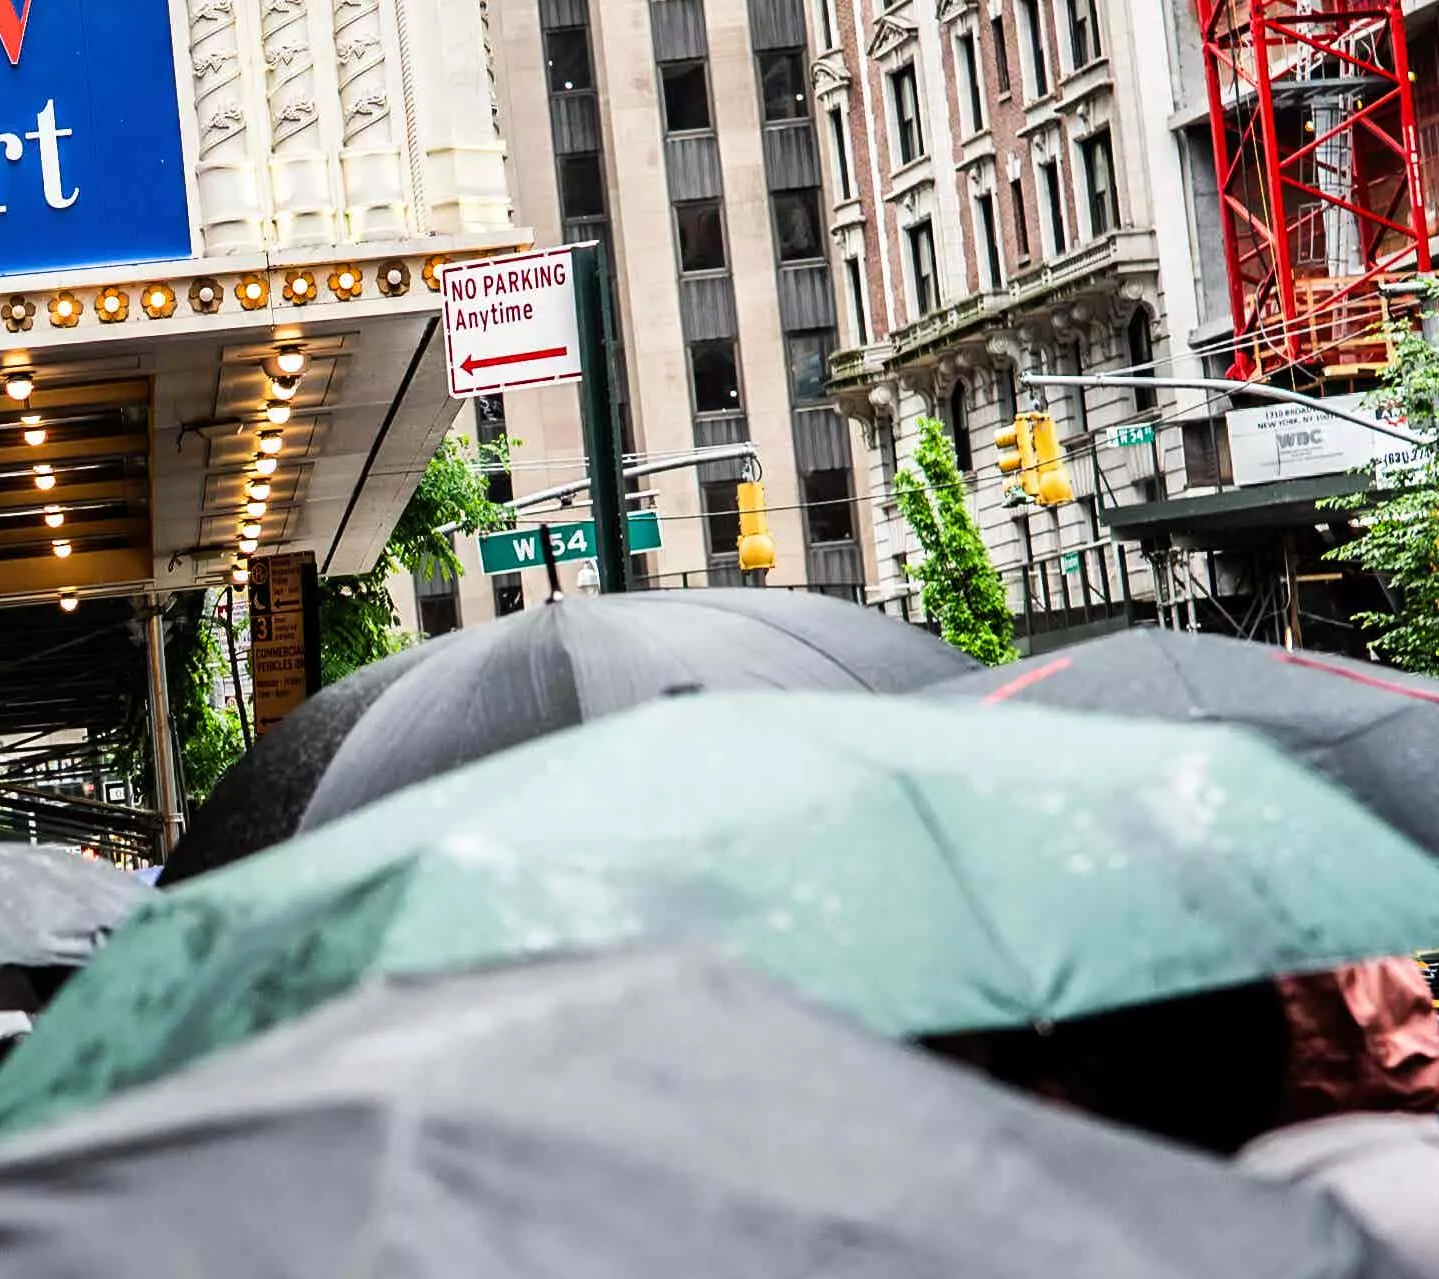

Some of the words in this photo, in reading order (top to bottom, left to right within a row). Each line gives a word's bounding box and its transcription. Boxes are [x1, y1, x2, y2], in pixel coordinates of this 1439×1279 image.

[451, 279, 479, 303] NO
[483, 262, 567, 298] PARKING
[455, 300, 534, 333] Anytime
[1257, 420, 1276, 430] NEW
[513, 539, 535, 562] W
[551, 531, 588, 557] 54
